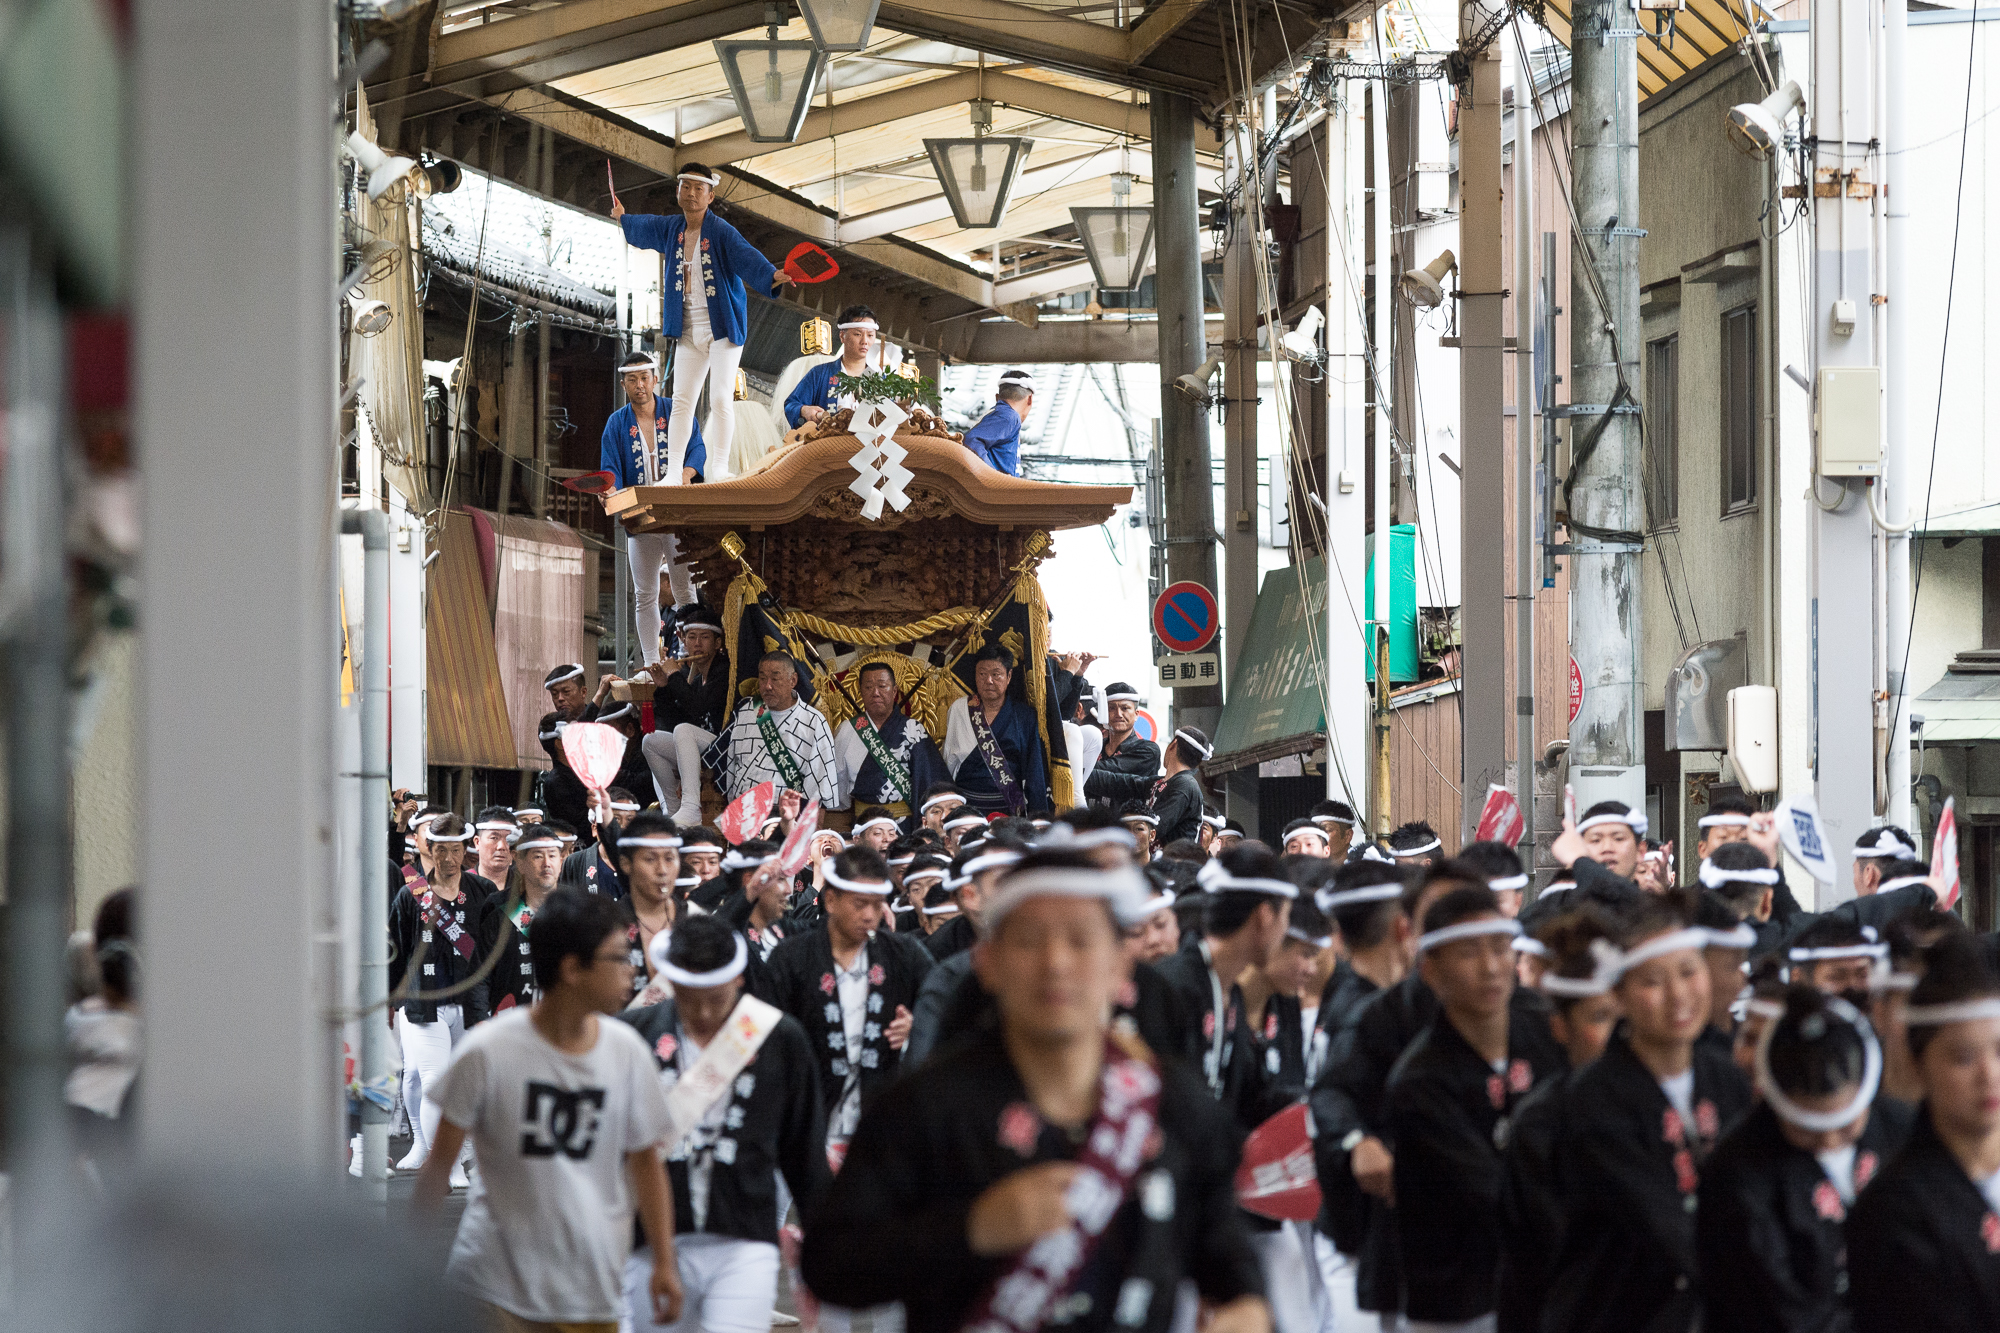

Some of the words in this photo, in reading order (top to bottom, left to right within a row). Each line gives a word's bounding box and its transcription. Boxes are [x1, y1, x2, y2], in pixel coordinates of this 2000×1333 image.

[701, 252, 716, 297] 大工方
[1162, 661, 1215, 680] 自動車
[770, 738, 802, 792] 副責任者
[972, 711, 1013, 785] 宮本町会長
[518, 942, 534, 995] 世話人
